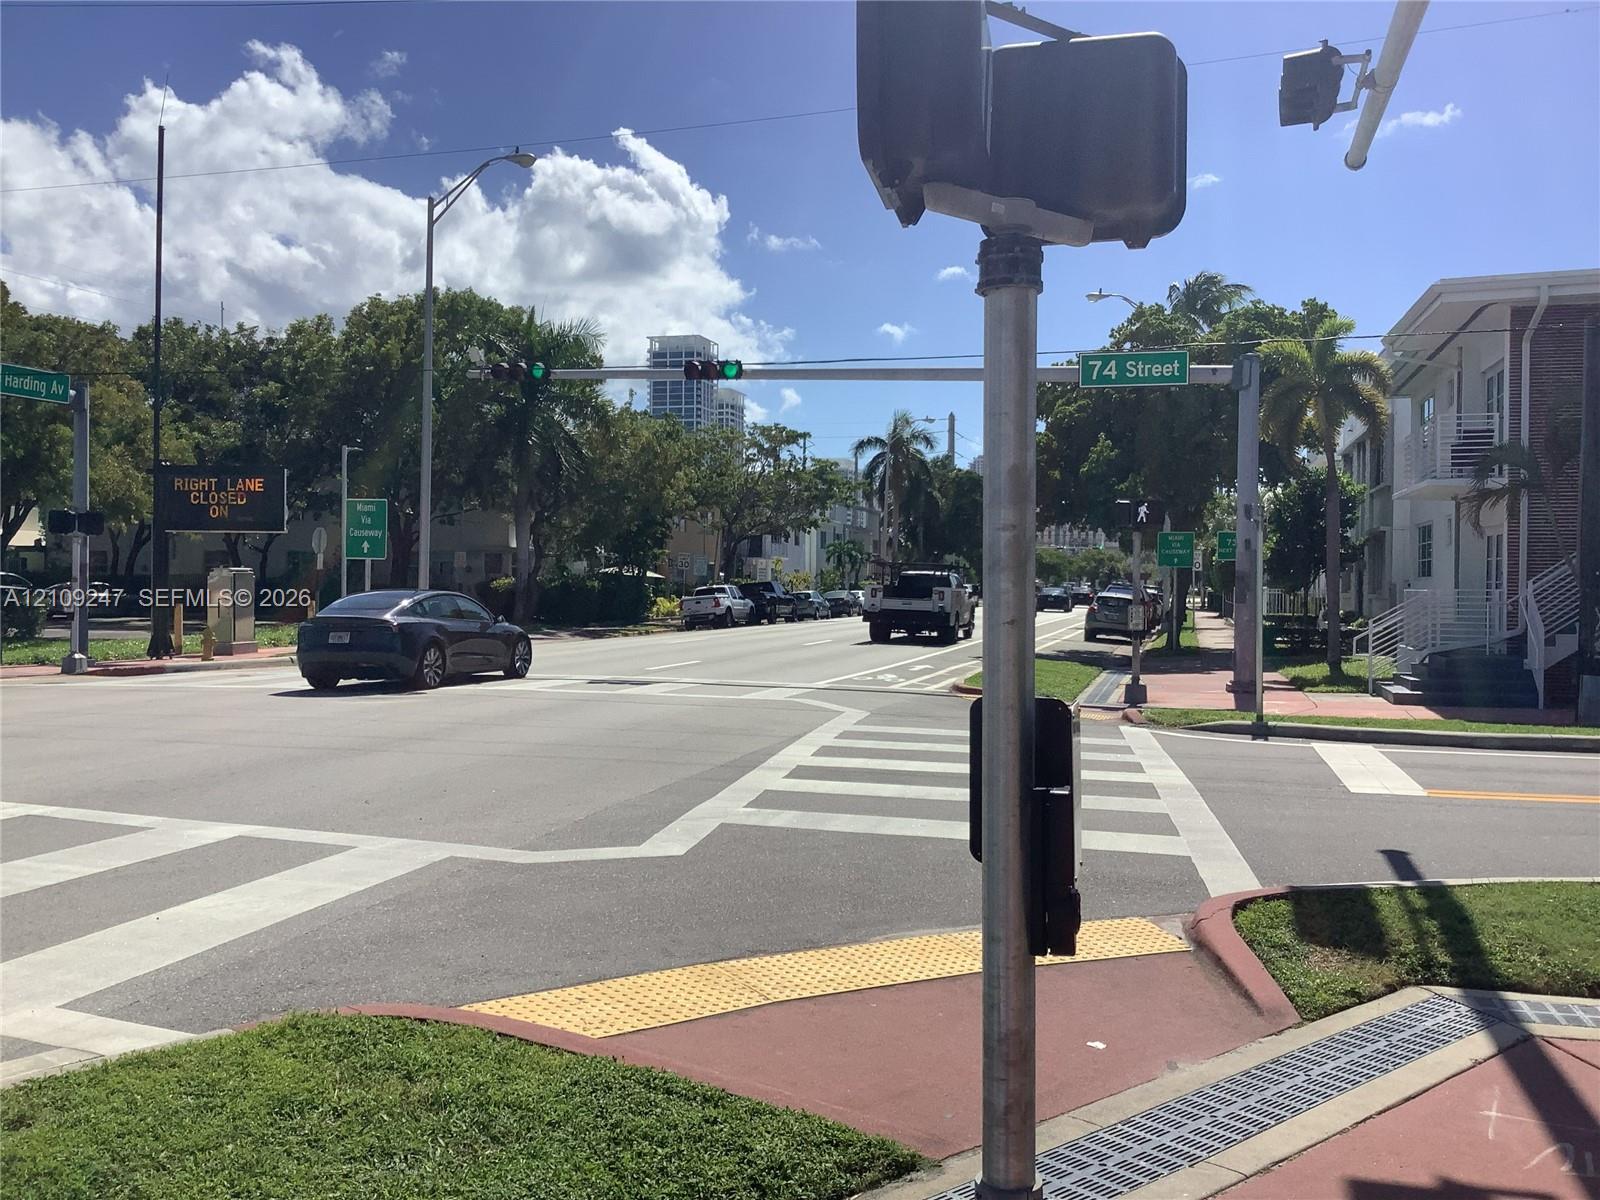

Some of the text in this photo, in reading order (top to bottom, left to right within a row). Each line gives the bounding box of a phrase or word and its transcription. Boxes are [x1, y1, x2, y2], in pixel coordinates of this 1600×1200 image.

[1088, 360, 1180, 380] 74 Street
[4, 373, 64, 397] Harding Av
[174, 478, 265, 491] RIGHT LANE
[190, 491, 247, 505] CLOSED
[209, 505, 228, 518] ON
[356, 503, 376, 512] Miami
[361, 515, 371, 524] Via
[349, 527, 382, 539] Causeway
